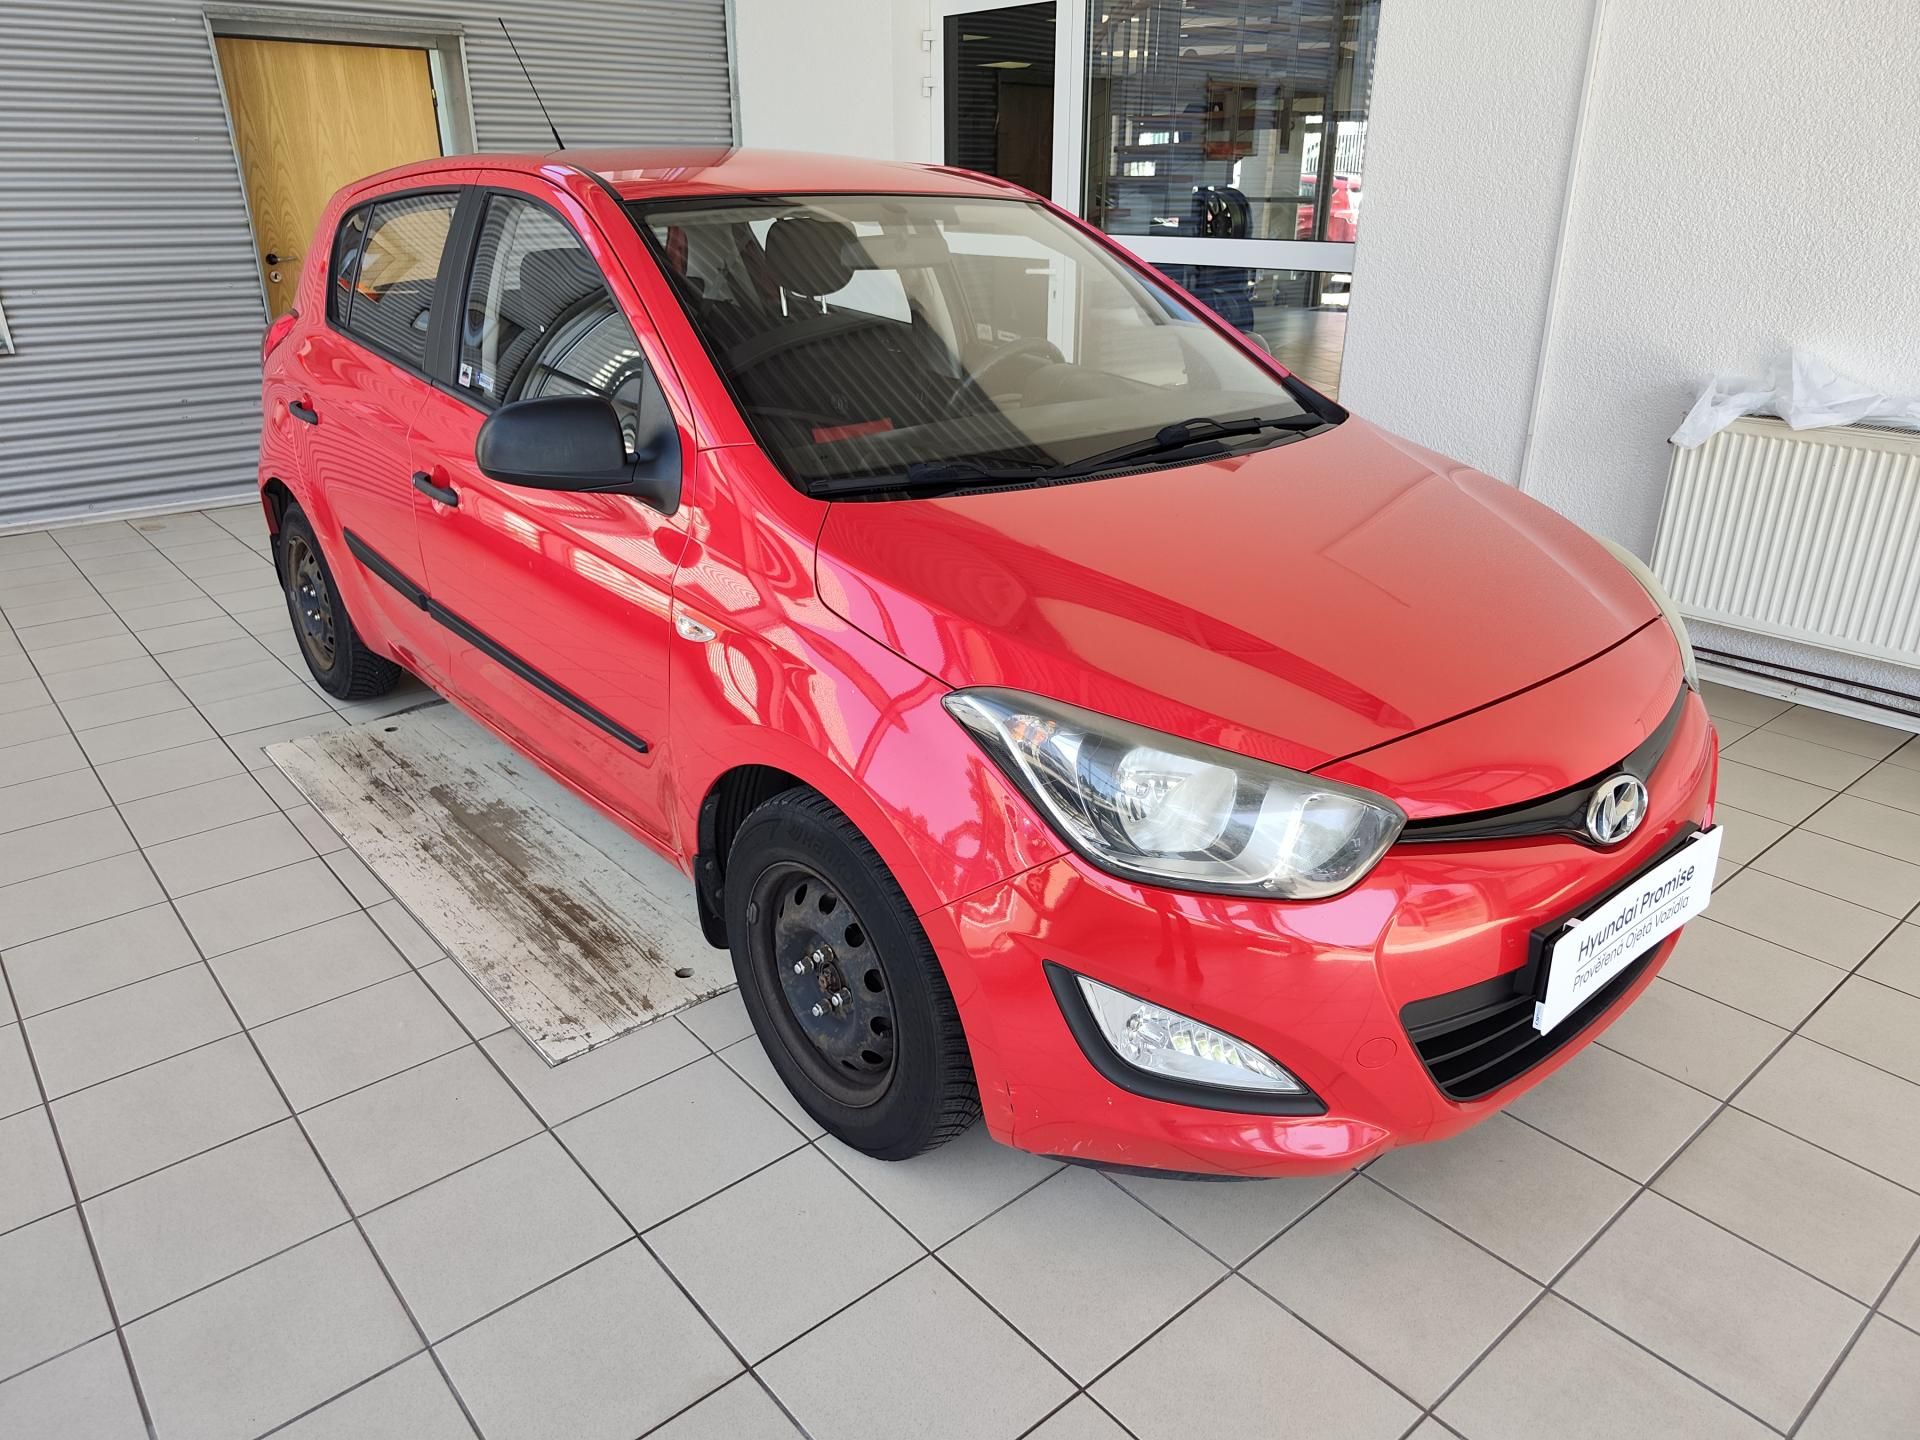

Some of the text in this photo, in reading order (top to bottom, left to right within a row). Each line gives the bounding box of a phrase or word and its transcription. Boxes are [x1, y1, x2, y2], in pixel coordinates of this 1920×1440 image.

[1573, 896, 1690, 992] Prověřená Ojetá Vozidla
[1578, 865, 1695, 962] Hyundai Promise
